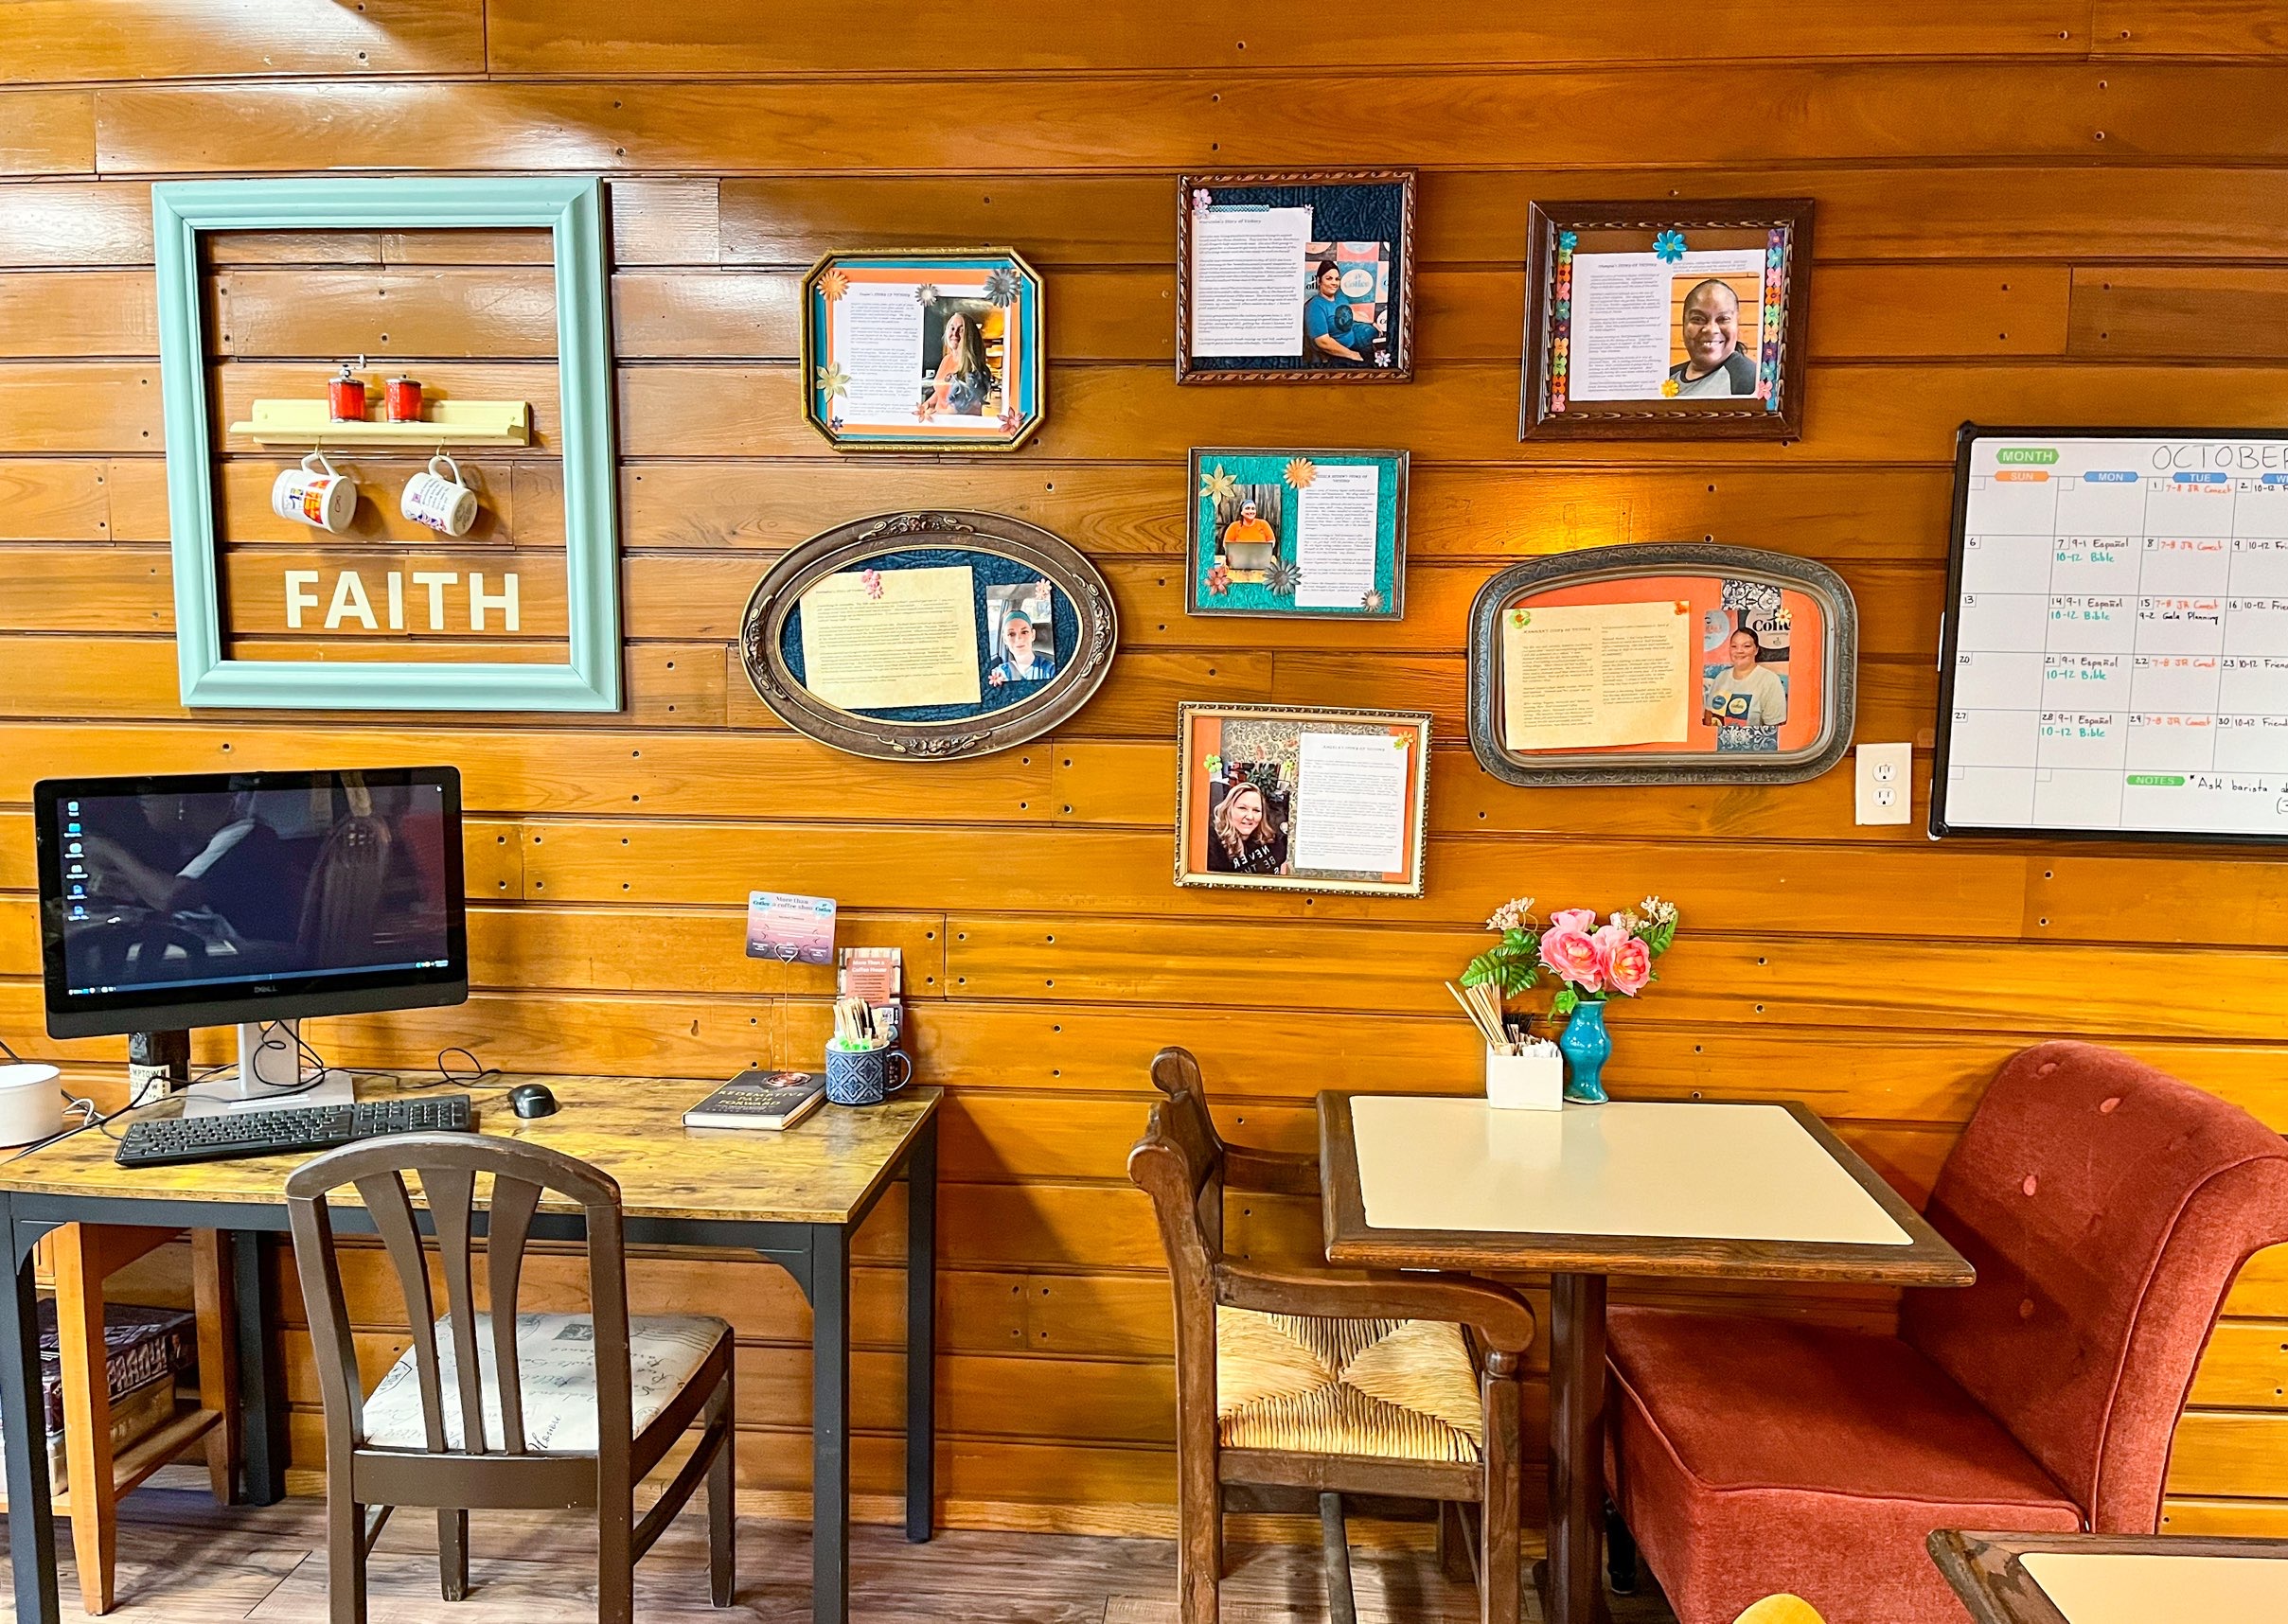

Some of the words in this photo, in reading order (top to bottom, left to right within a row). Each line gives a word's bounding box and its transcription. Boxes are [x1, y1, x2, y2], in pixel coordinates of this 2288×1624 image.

[2002, 450, 2053, 462] MONTH
[2010, 472, 2034, 482] SUN
[2098, 473, 2123, 482] MON
[1969, 538, 1977, 547] 6
[2057, 538, 2065, 549] 7
[2072, 539, 2086, 549] 9-1
[2147, 538, 2154, 548] 8
[2234, 540, 2241, 550] 9
[2248, 541, 2270, 550] 10-12
[2056, 553, 2083, 562] 10-12
[2090, 553, 2115, 562] Bible
[285, 571, 520, 631] FAITH
[1964, 595, 1974, 604] 13
[2066, 597, 2082, 607] 9-1
[2140, 599, 2150, 608] 15
[2228, 600, 2238, 609] 16
[2244, 601, 2266, 609] 10-12
[2050, 610, 2078, 620] 10-12
[2084, 611, 2110, 621] Bible
[2138, 611, 2155, 620] 9-2
[2188, 611, 2219, 626] Planning
[1959, 656, 1970, 664] 20
[2062, 657, 2075, 665] 9-1
[2223, 659, 2235, 667] 23
[2239, 659, 2258, 668] 10-12
[2047, 670, 2076, 680] 10-12
[2081, 669, 2107, 680] Bible
[2058, 714, 2072, 723] 9-1
[2218, 717, 2230, 726] 30
[2235, 718, 2255, 727] 10-12
[2262, 717, 2288, 727] Friend
[2041, 727, 2072, 736] 10-12
[2079, 727, 2105, 737] Bible
[2136, 776, 2174, 785] NOTES
[2231, 779, 2268, 793] barista
[130, 1068, 167, 1078] MPTOWN
